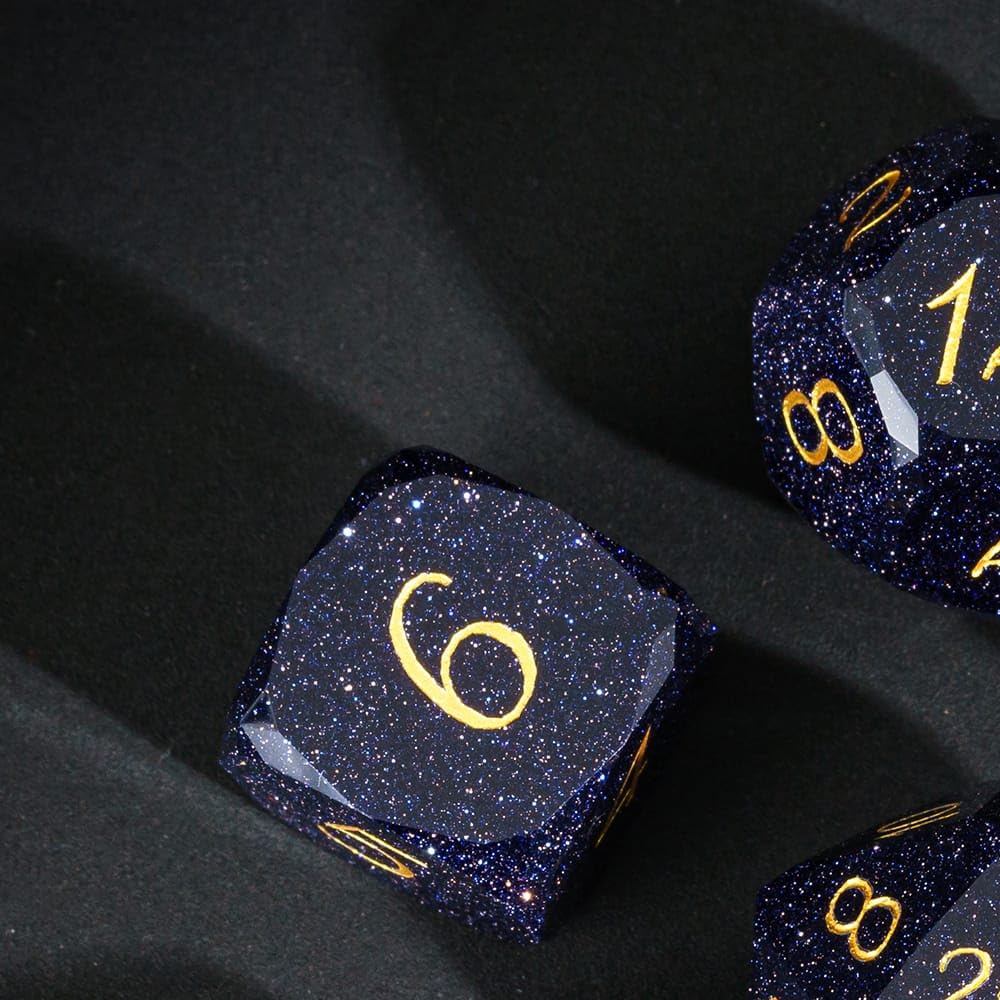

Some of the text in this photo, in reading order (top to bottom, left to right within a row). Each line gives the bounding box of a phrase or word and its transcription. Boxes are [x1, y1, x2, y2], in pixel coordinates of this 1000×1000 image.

[839, 168, 912, 252] 2
[782, 377, 865, 466] 8
[388, 571, 539, 731] 6
[824, 876, 902, 963] 8
